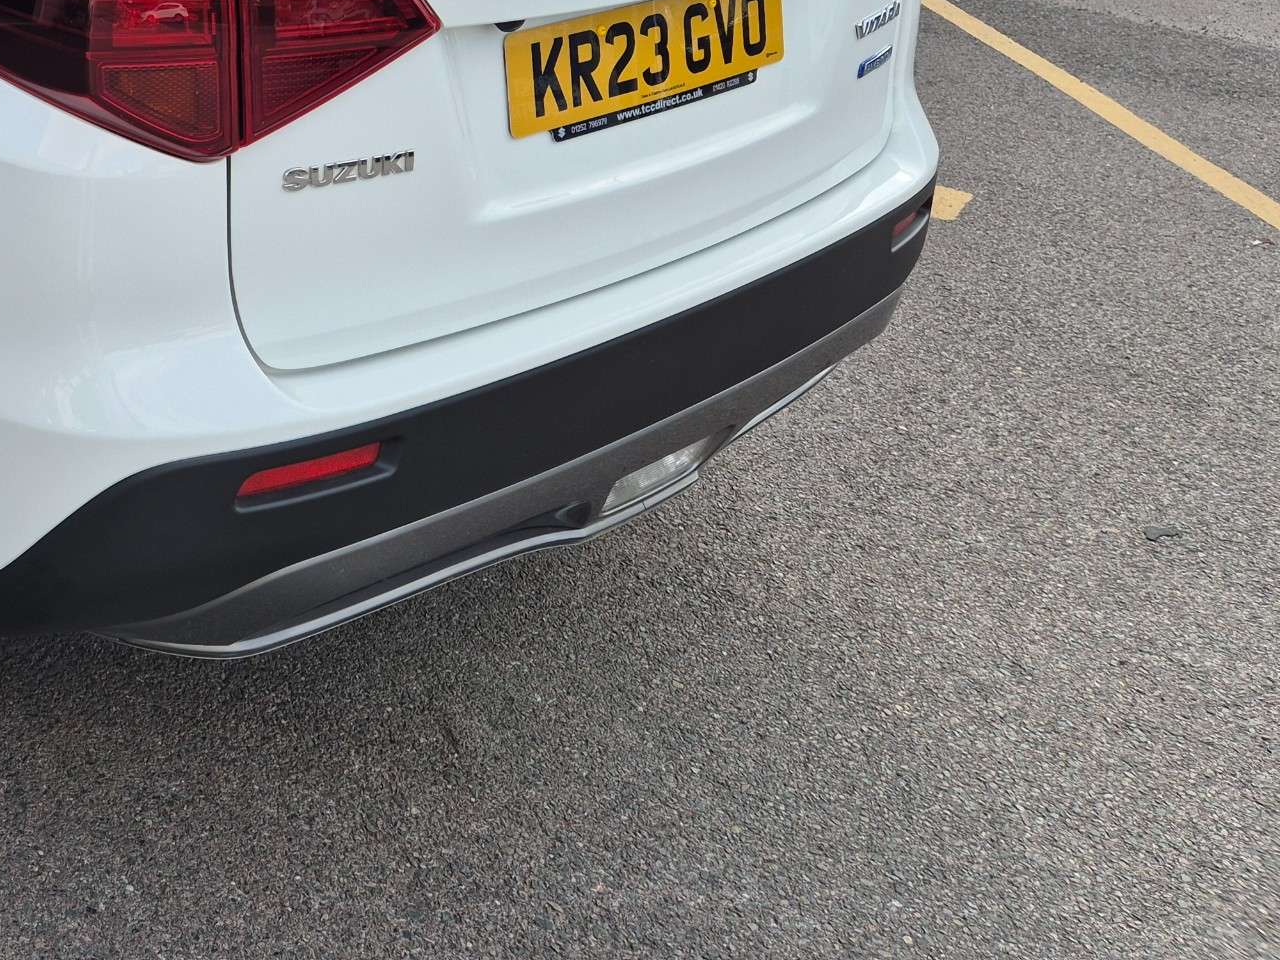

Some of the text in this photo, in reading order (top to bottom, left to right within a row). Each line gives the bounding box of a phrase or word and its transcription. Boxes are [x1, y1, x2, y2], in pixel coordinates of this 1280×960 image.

[530, 13, 670, 118] KR23
[616, 87, 704, 122] www.tccdirect.co.uk
[280, 149, 416, 192] SUZUKI
